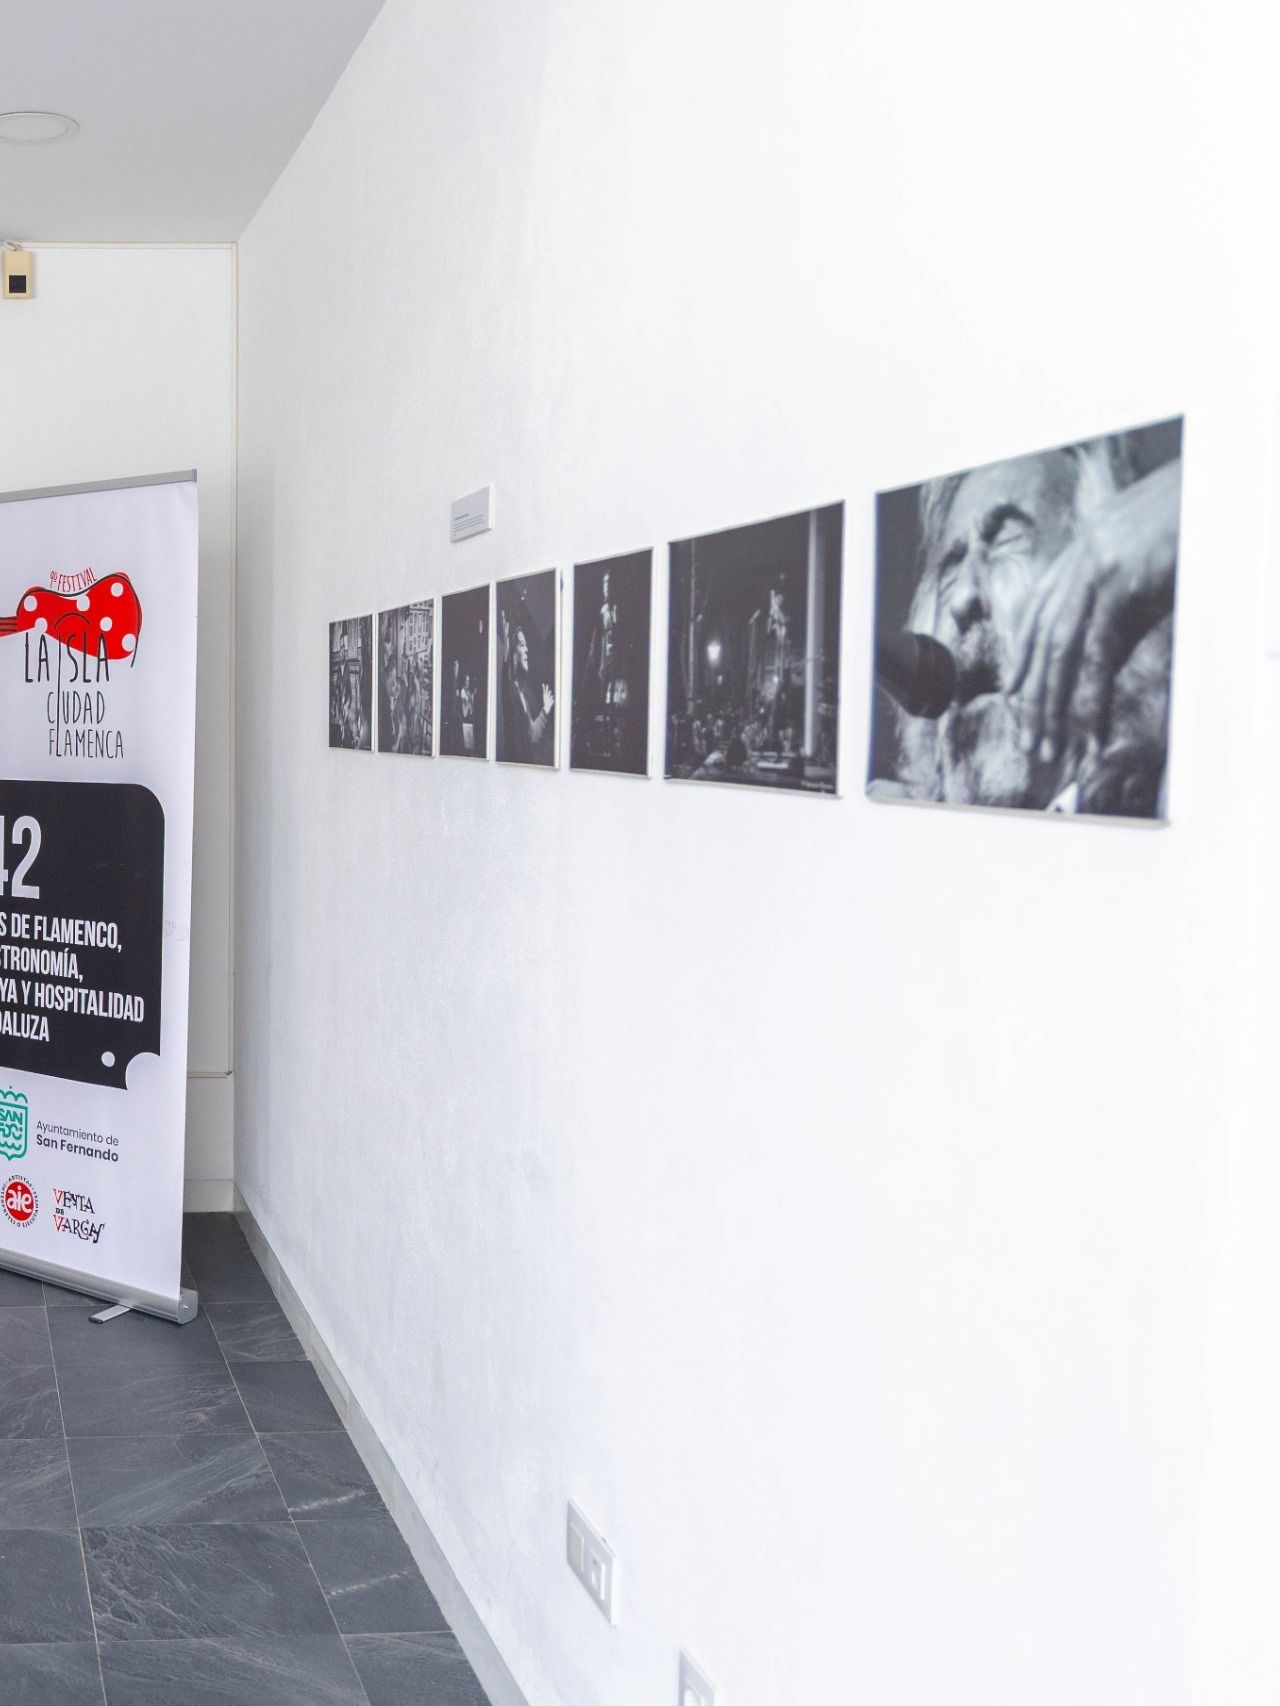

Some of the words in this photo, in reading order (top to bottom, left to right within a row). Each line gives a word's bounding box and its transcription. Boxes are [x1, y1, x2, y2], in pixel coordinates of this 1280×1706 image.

[58, 567, 97, 592] FESTIVAL
[25, 632, 50, 682] LA
[58, 632, 109, 683] ISLA
[47, 691, 105, 724] CIUDAD
[49, 729, 123, 758] FLAMENCA
[11, 912, 30, 938] DE
[34, 916, 122, 953] FLAMENCO,
[21, 980, 32, 1005] Y
[35, 982, 144, 1023] HOSPITALIDAD
[36, 1120, 103, 1144] Ayuntamiento
[106, 1134, 119, 1146] de
[36, 1134, 58, 1149] San
[61, 1139, 119, 1162] Fernando
[7, 1185, 32, 1213] aie
